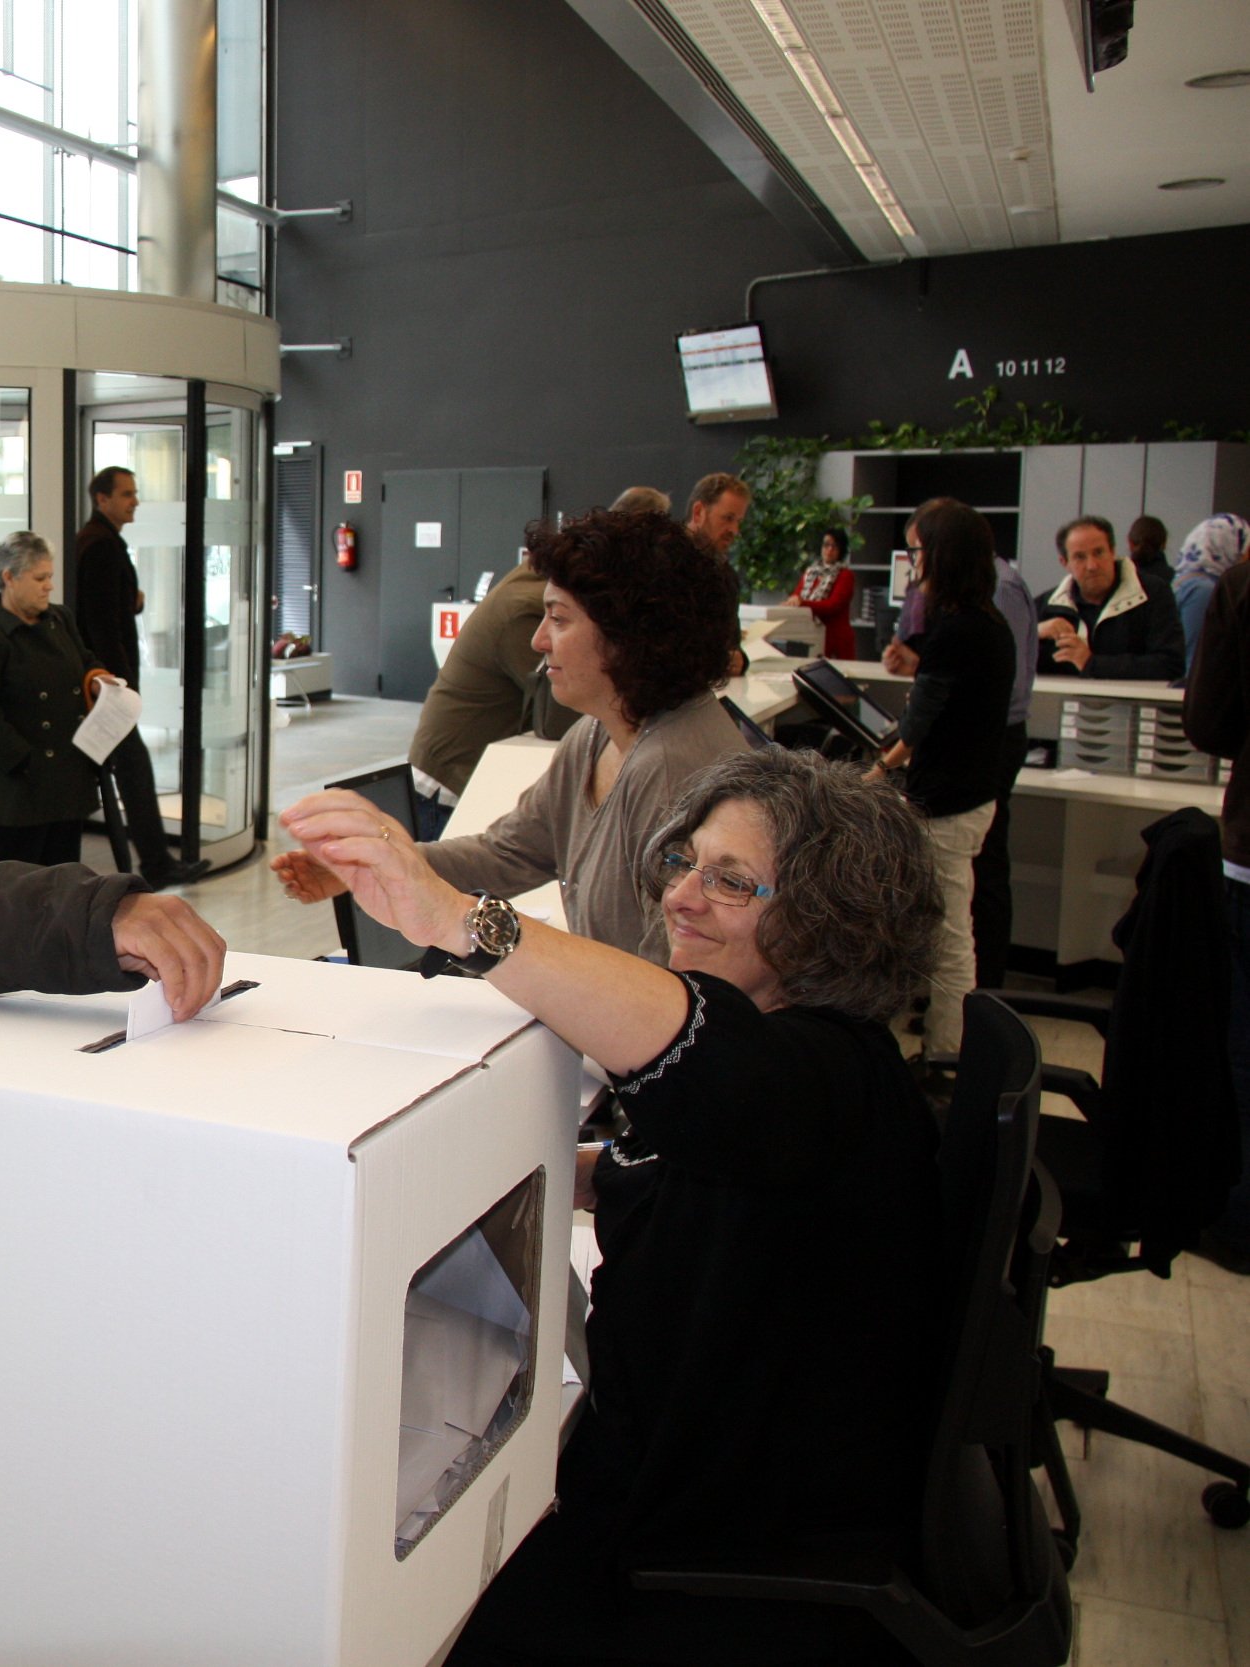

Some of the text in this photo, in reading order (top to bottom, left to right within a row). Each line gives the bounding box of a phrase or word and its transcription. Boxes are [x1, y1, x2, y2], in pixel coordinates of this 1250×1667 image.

[948, 348, 1066, 379] A 10 11 12
